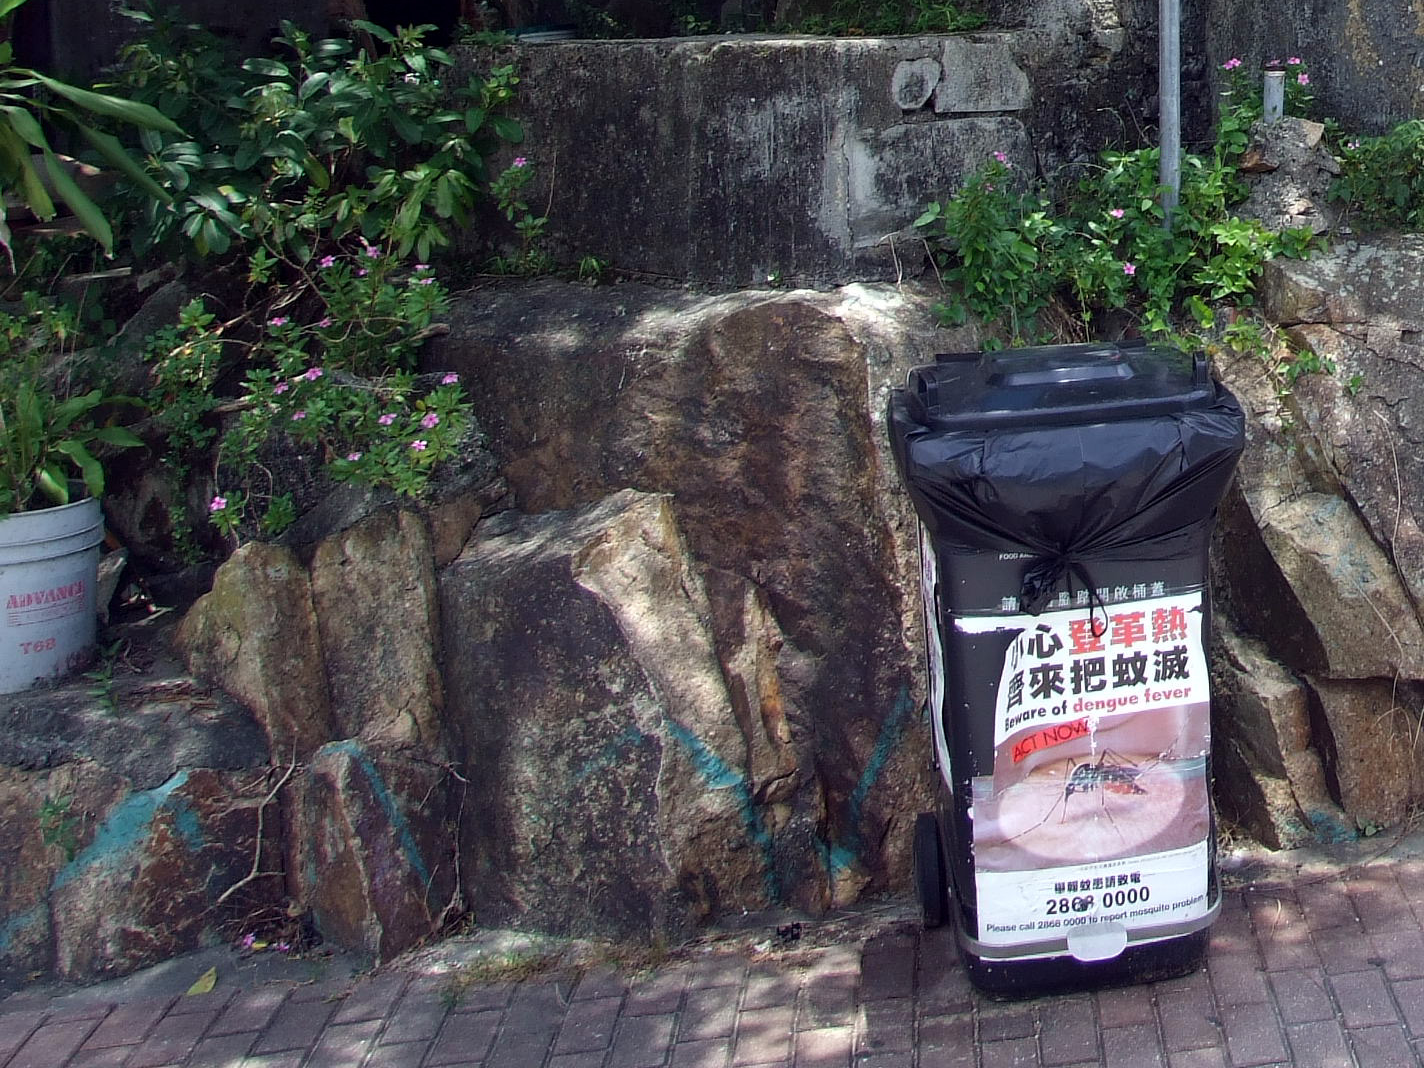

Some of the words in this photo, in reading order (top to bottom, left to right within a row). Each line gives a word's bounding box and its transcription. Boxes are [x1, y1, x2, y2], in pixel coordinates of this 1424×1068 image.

[1010, 606, 1188, 671] 小心登革熱
[1006, 645, 1190, 712] 齊來把蚊滅
[1005, 707, 1047, 732] Beware
[1051, 699, 1067, 715] of
[1073, 696, 1139, 713] dengue
[1144, 686, 1192, 703] fever
[1013, 733, 1038, 763] ACT
[1043, 719, 1089, 746] NOW
[986, 923, 1017, 932] Please
[1019, 921, 1035, 931] call
[1038, 918, 1061, 929] 2868
[1063, 916, 1087, 926] 0000
[1089, 915, 1098, 924] to
[1100, 911, 1128, 923] report
[1129, 902, 1170, 918] mosquito
[1172, 893, 1204, 911] problem
[1046, 895, 1095, 915] 2868
[1102, 886, 1150, 909] 0000
